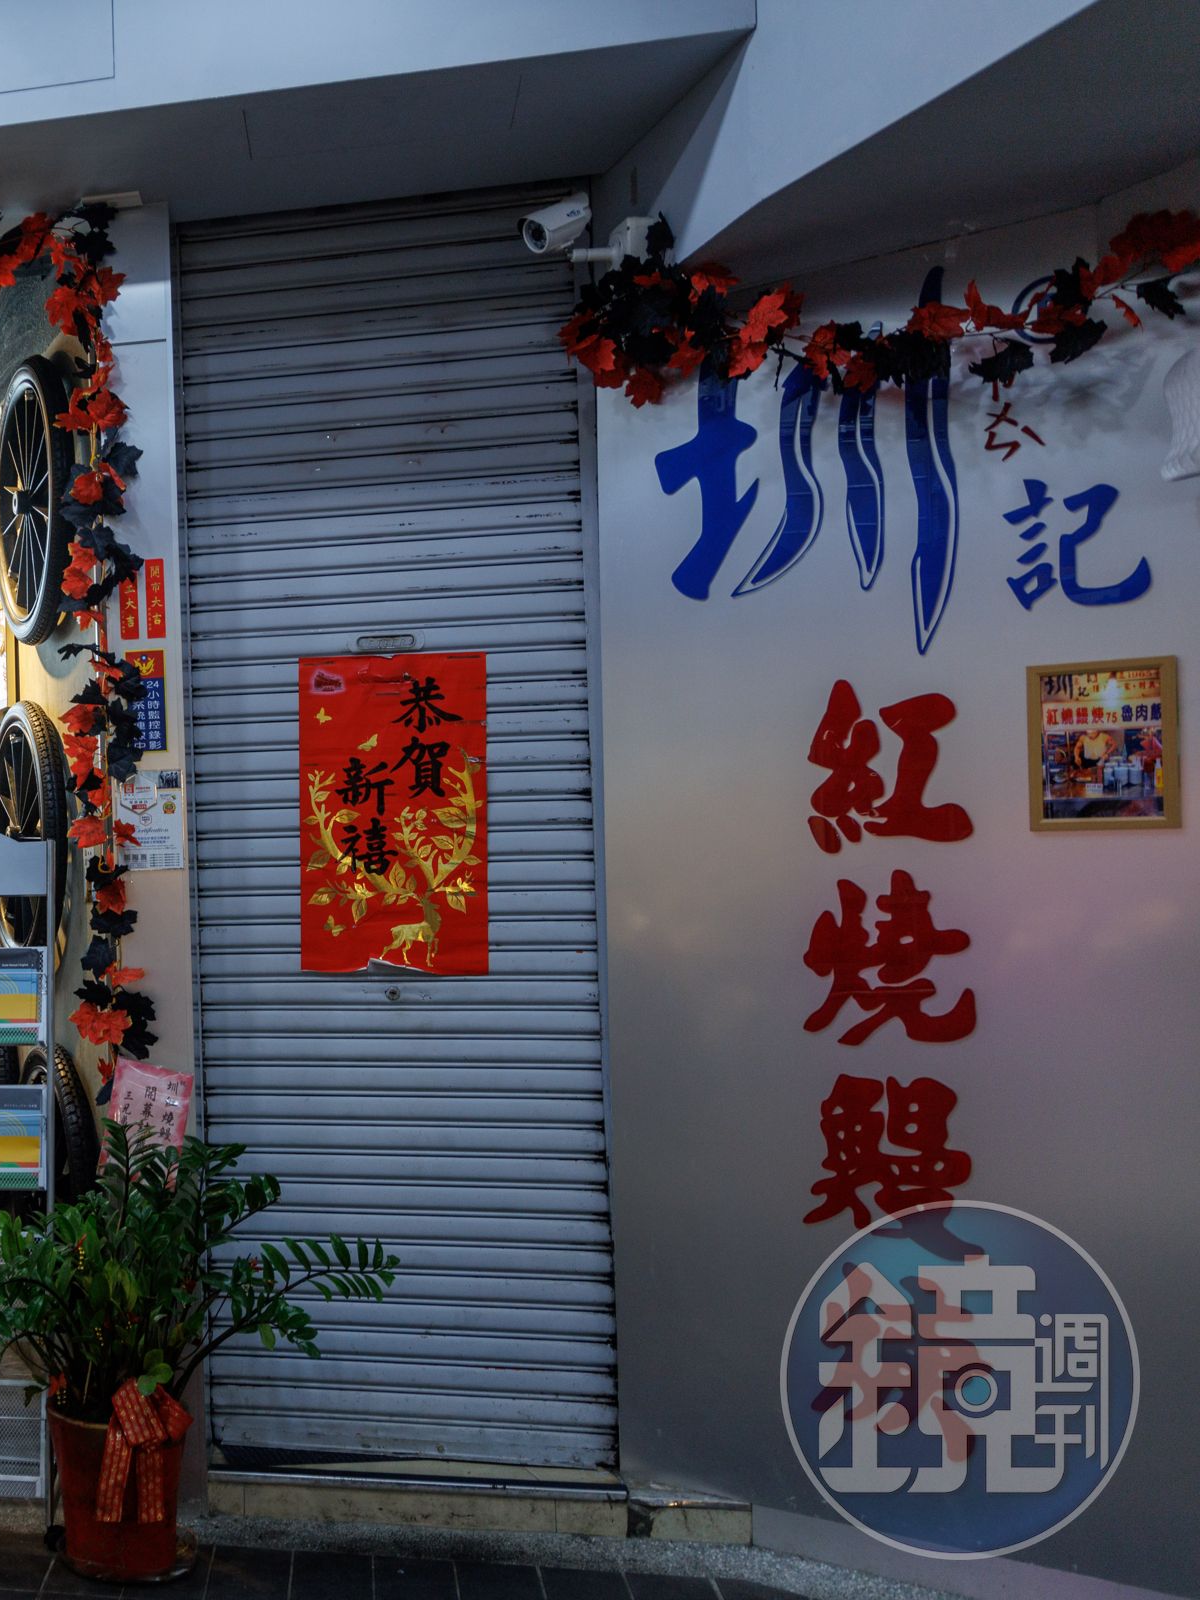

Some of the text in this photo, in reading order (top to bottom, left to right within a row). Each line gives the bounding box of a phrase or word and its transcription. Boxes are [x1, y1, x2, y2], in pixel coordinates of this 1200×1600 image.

[124, 584, 137, 628] 工大吉
[150, 565, 163, 625] 開市大吉
[391, 676, 464, 799] 恭賀
[336, 756, 398, 876] 新禧
